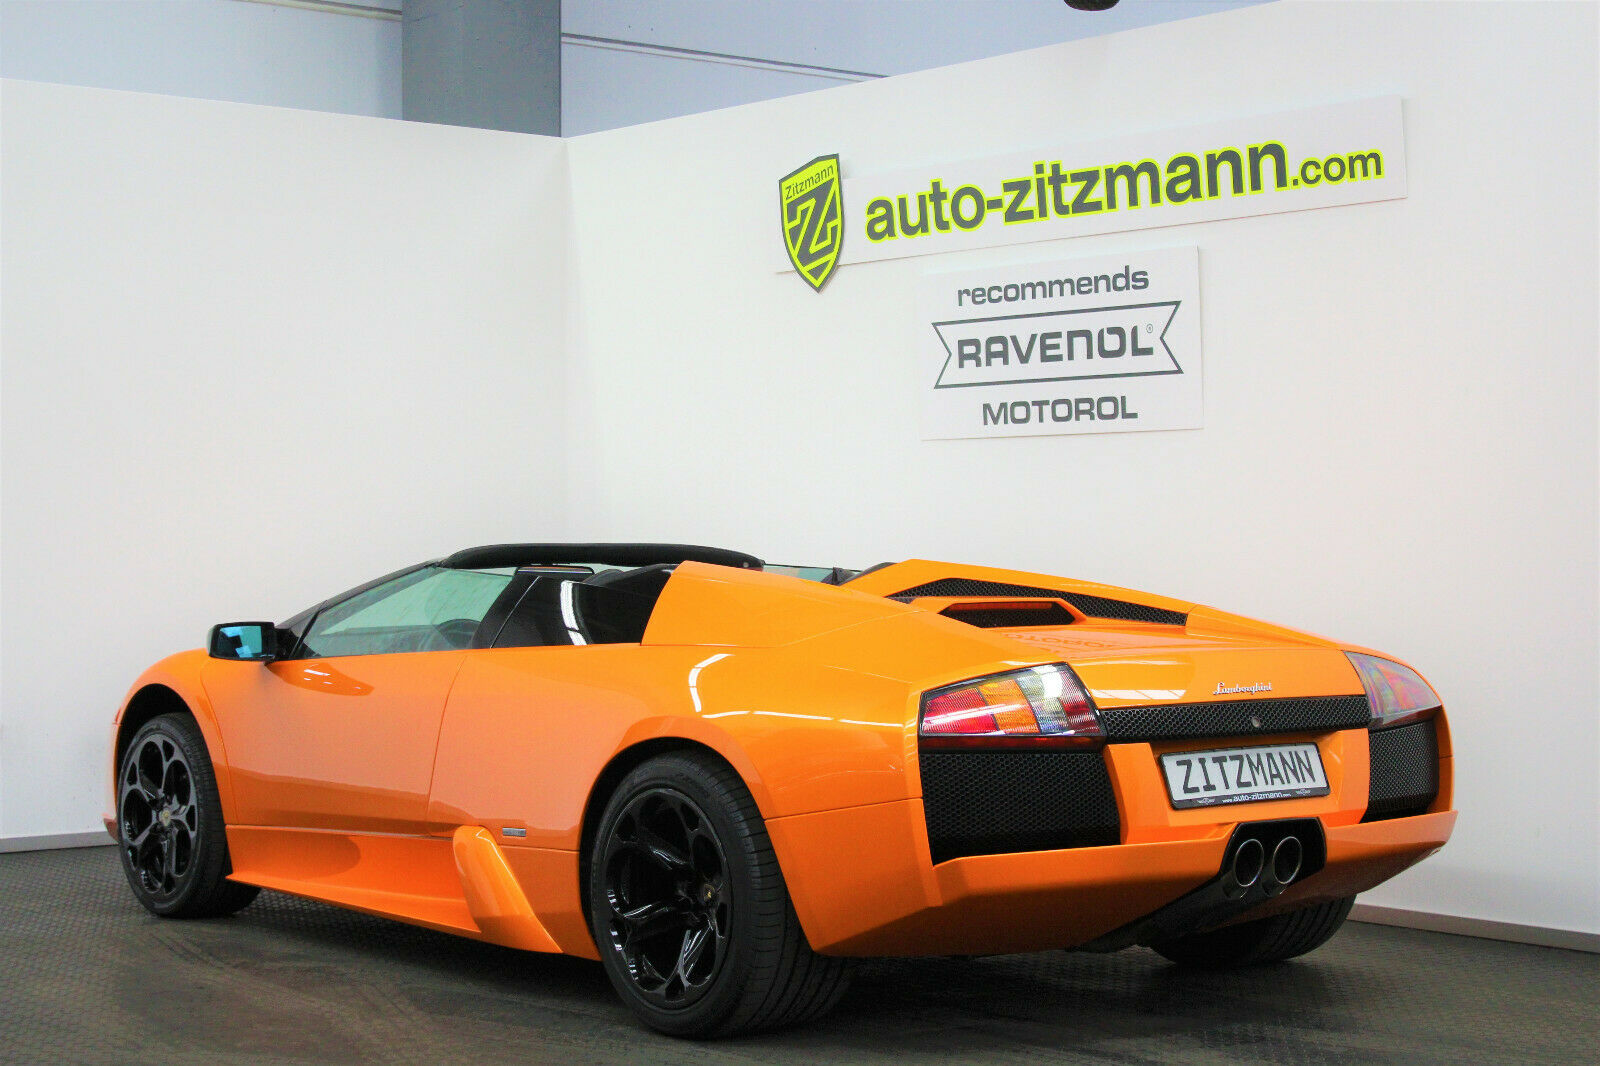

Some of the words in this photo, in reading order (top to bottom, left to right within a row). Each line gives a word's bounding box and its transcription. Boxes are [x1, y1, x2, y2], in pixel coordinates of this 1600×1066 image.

[785, 165, 834, 200] Zitzmann
[866, 140, 1385, 243] auto-zitzmann.com
[957, 265, 1150, 306] recommends
[982, 396, 1139, 426] MOTOROL
[1213, 682, 1273, 695] Lamborghini
[1176, 751, 1316, 794] ZITZMANN
